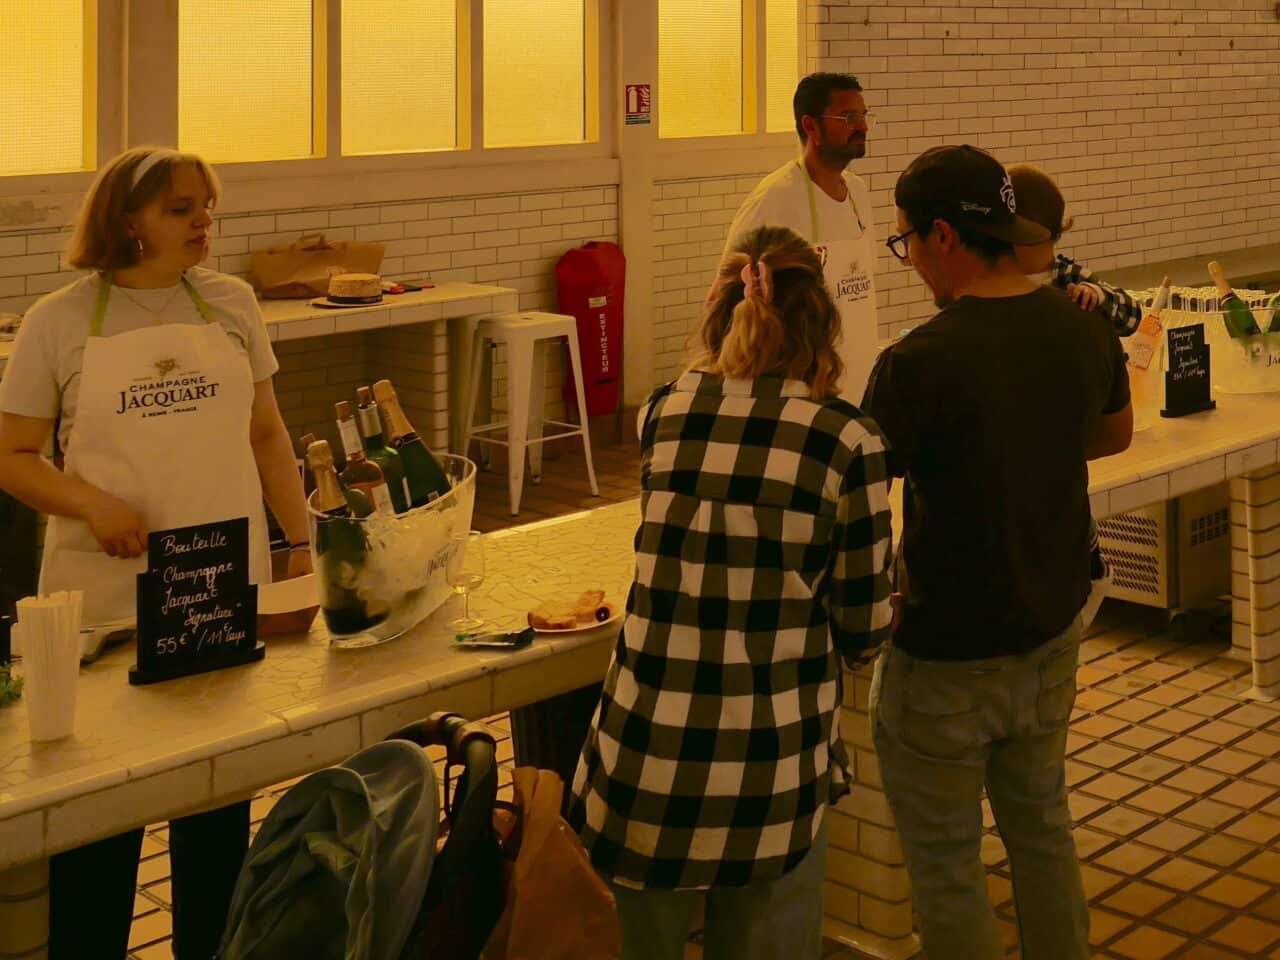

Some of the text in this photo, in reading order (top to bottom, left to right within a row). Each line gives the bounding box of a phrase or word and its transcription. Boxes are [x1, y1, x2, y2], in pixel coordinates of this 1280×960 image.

[129, 375, 208, 393] CHAMPAGNE
[116, 383, 220, 415] JACQUART
[159, 531, 228, 558] Bouteille
[160, 586, 219, 616] Jacquart
